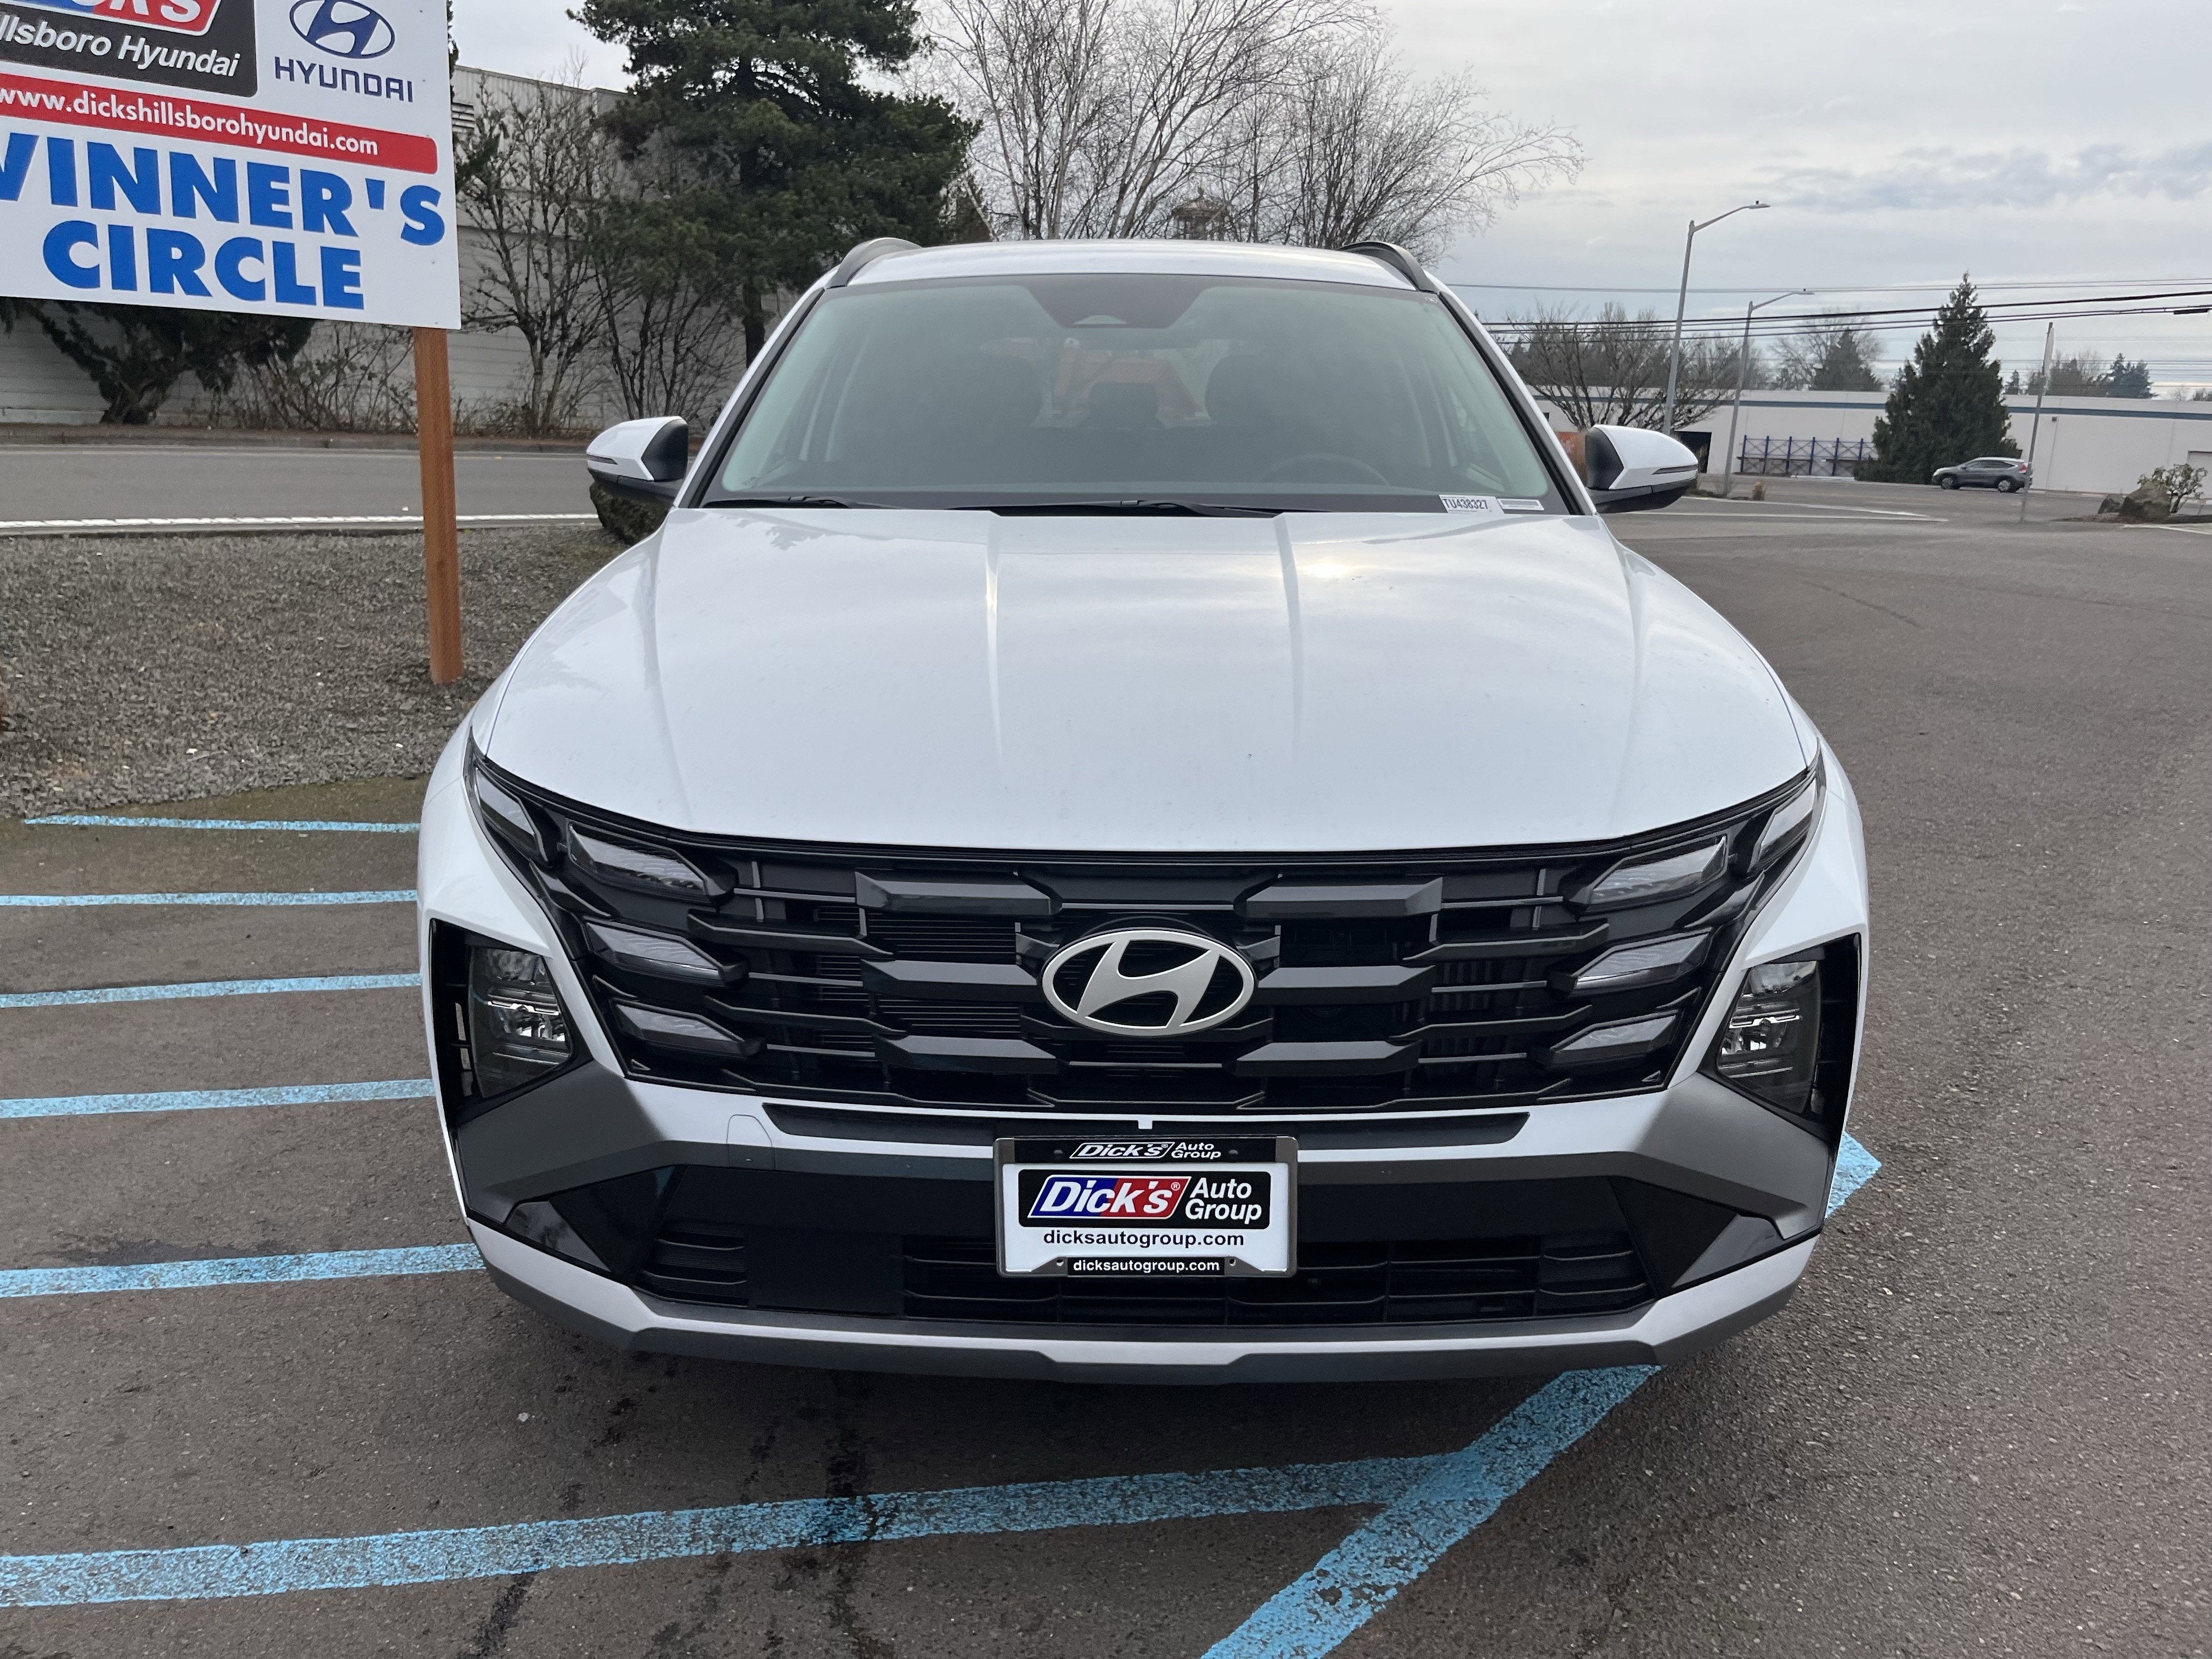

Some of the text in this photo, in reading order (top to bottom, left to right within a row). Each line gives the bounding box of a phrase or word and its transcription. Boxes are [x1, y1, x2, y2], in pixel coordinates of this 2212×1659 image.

[118, 35, 241, 76] Hyundai
[274, 56, 413, 103] HYUNDAI
[0, 88, 379, 156] www.dickshillsborohyundai.com
[42, 220, 364, 310] CIRCLE
[1442, 498, 1488, 510] TU438327
[1171, 1150, 1221, 1160] Group
[1176, 1142, 1215, 1150] Auto
[1189, 1177, 1252, 1199] Auto
[1185, 1199, 1262, 1224] Group
[1043, 1229, 1244, 1249] dicksautogroup.com
[1073, 1260, 1220, 1273] dicksautogroup.com
